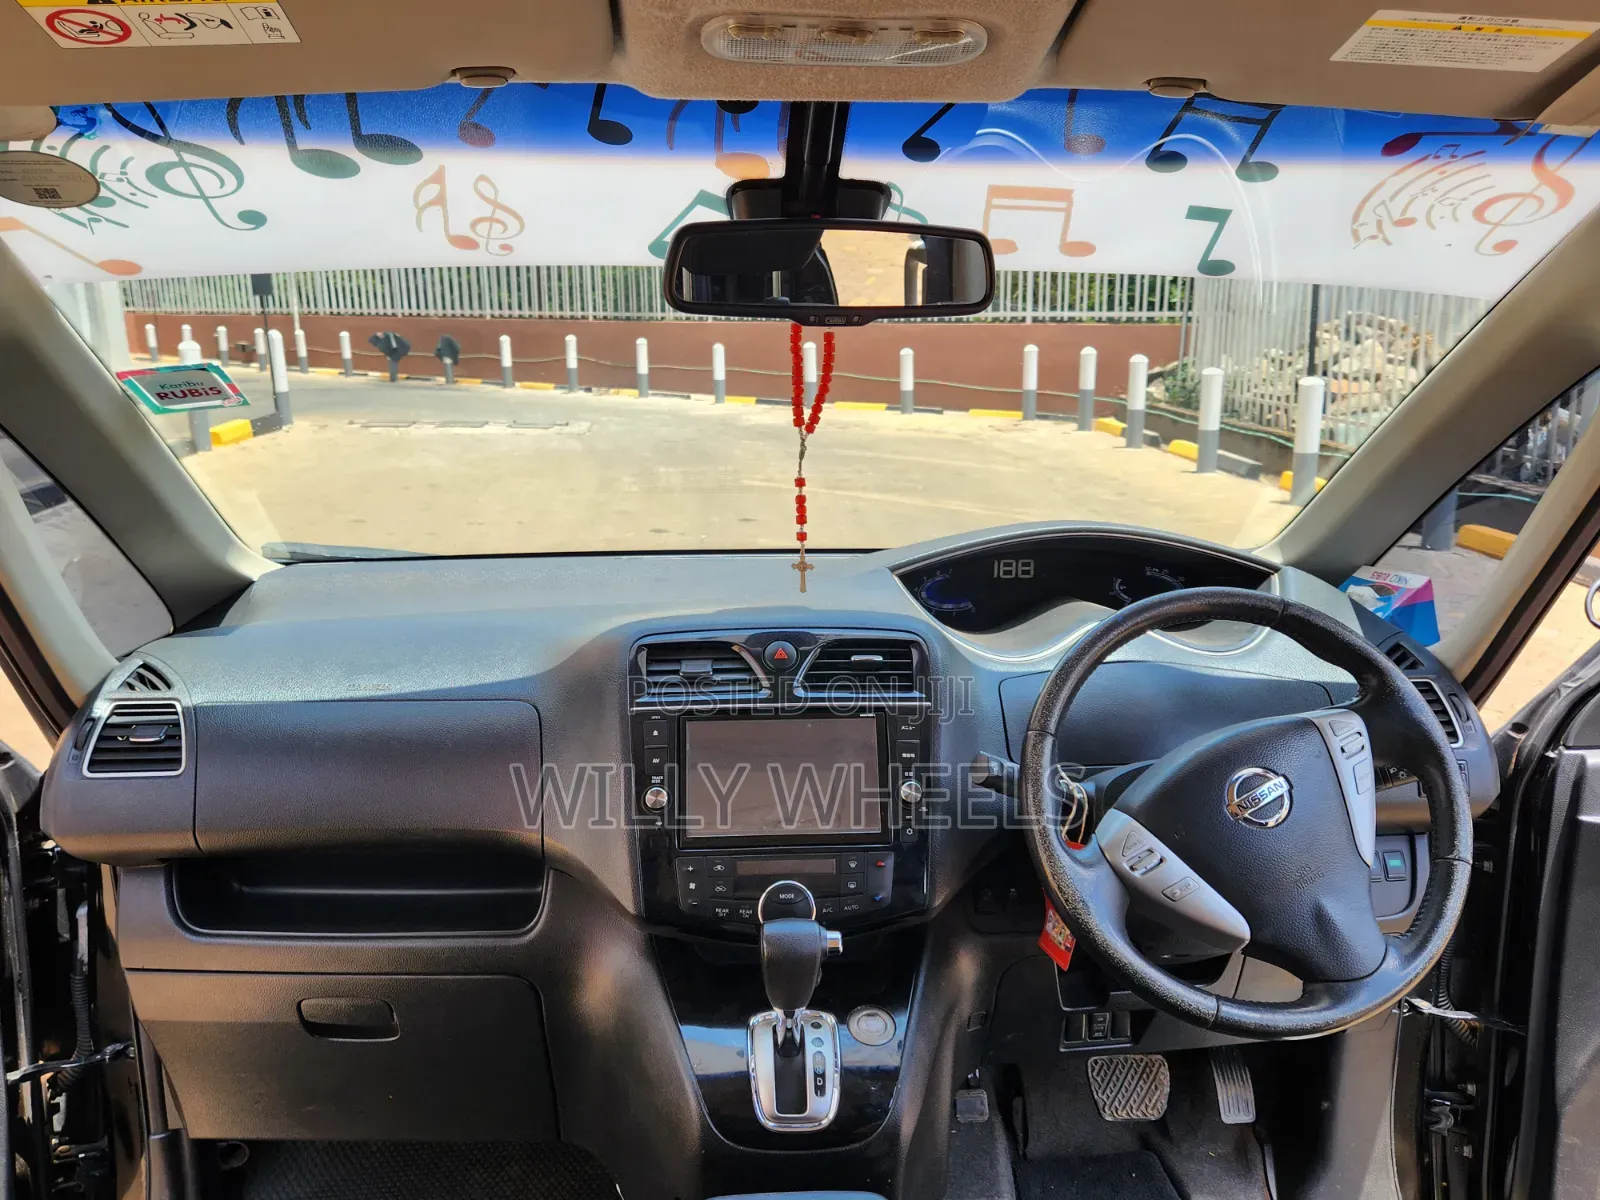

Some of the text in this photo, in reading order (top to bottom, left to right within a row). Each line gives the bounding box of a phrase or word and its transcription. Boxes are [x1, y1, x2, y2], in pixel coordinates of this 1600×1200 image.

[159, 380, 204, 390] Karibu
[993, 559, 1035, 579] 188
[1235, 780, 1284, 813] NISSAN
[817, 1077, 823, 1085] D
